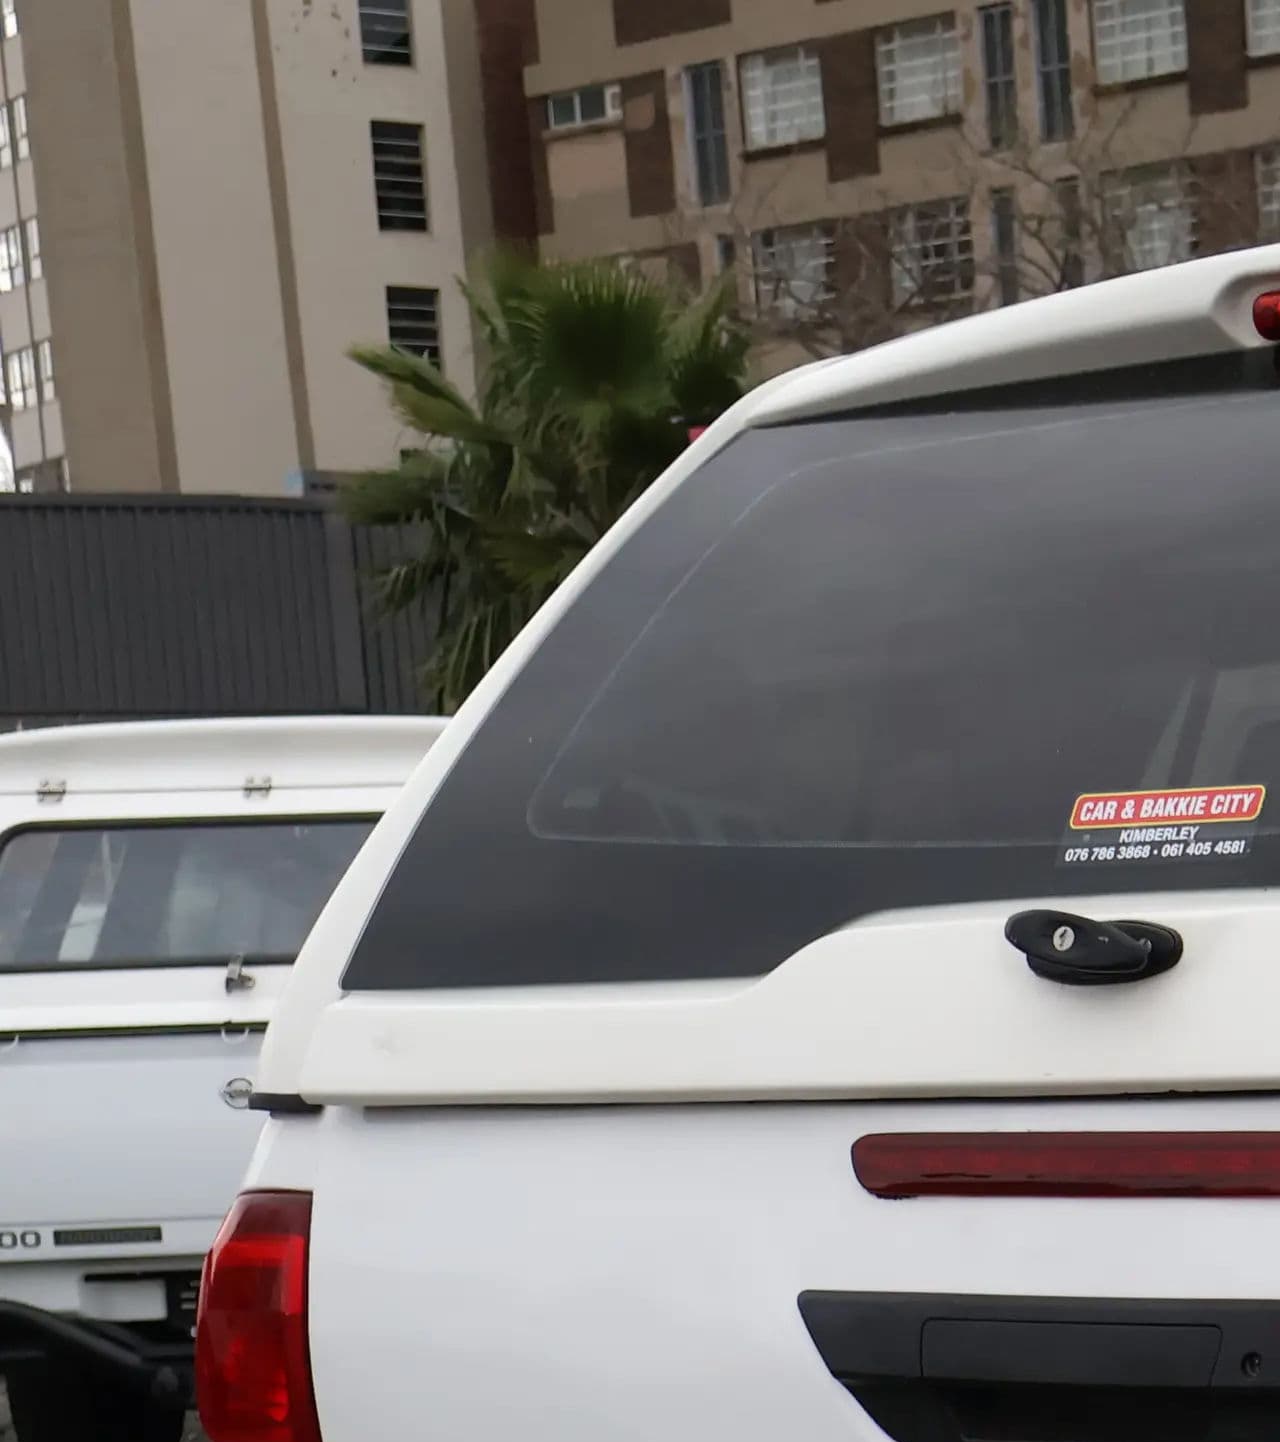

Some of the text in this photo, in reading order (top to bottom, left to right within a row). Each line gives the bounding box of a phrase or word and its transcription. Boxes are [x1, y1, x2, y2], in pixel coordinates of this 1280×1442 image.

[1079, 793, 1256, 822] CAR & BAKKIE CITY
[1119, 826, 1200, 843] KIMBERLEY
[1064, 840, 1245, 862] 076 786 3868 061 405 4581
